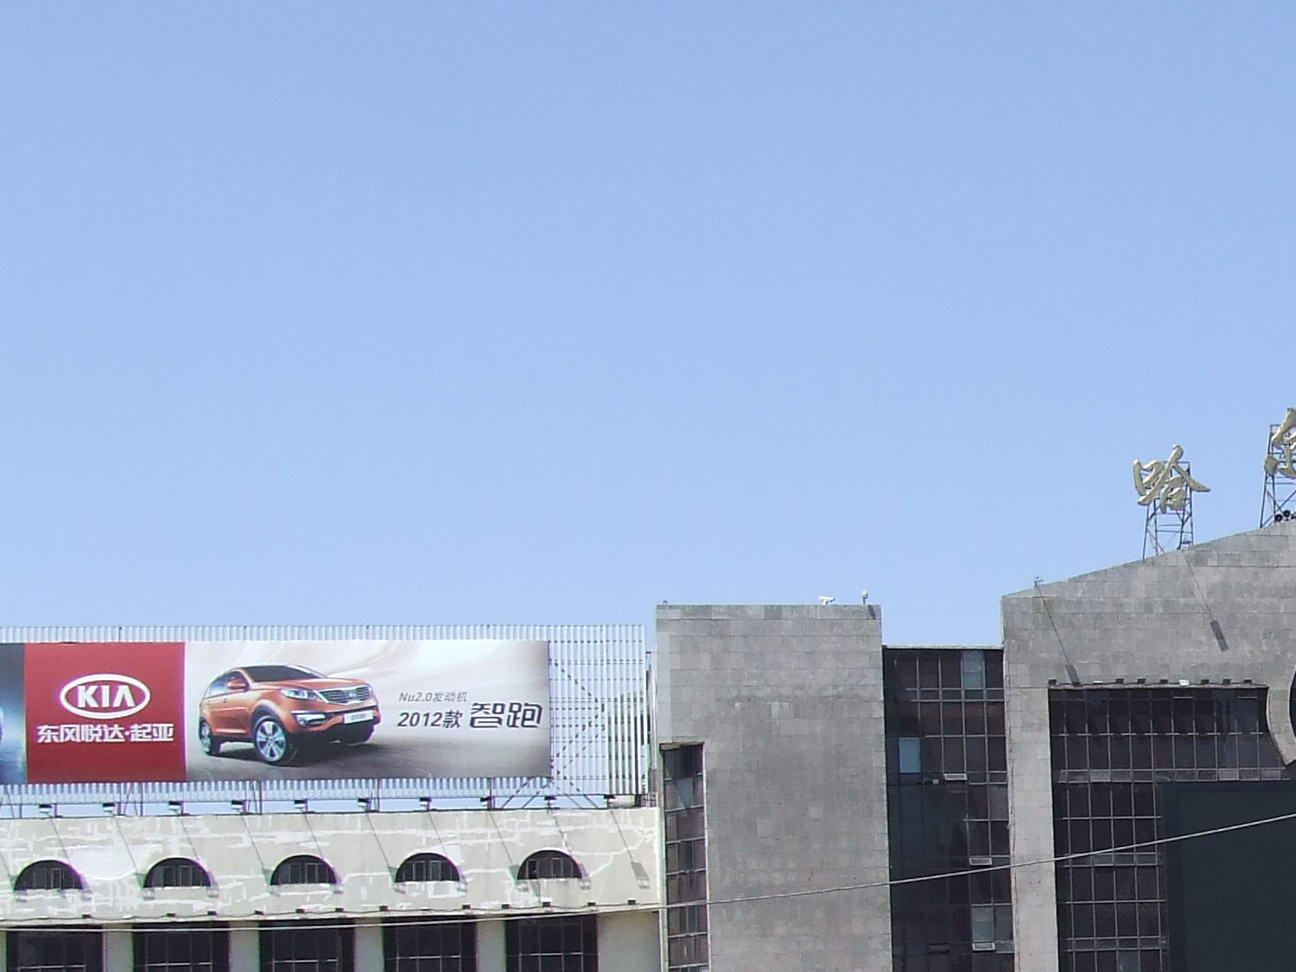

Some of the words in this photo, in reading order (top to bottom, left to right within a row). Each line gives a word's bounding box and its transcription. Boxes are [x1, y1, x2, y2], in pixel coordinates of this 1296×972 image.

[77, 685, 136, 708] KIA
[397, 710, 463, 728] 2012款
[470, 702, 543, 728] 智跑
